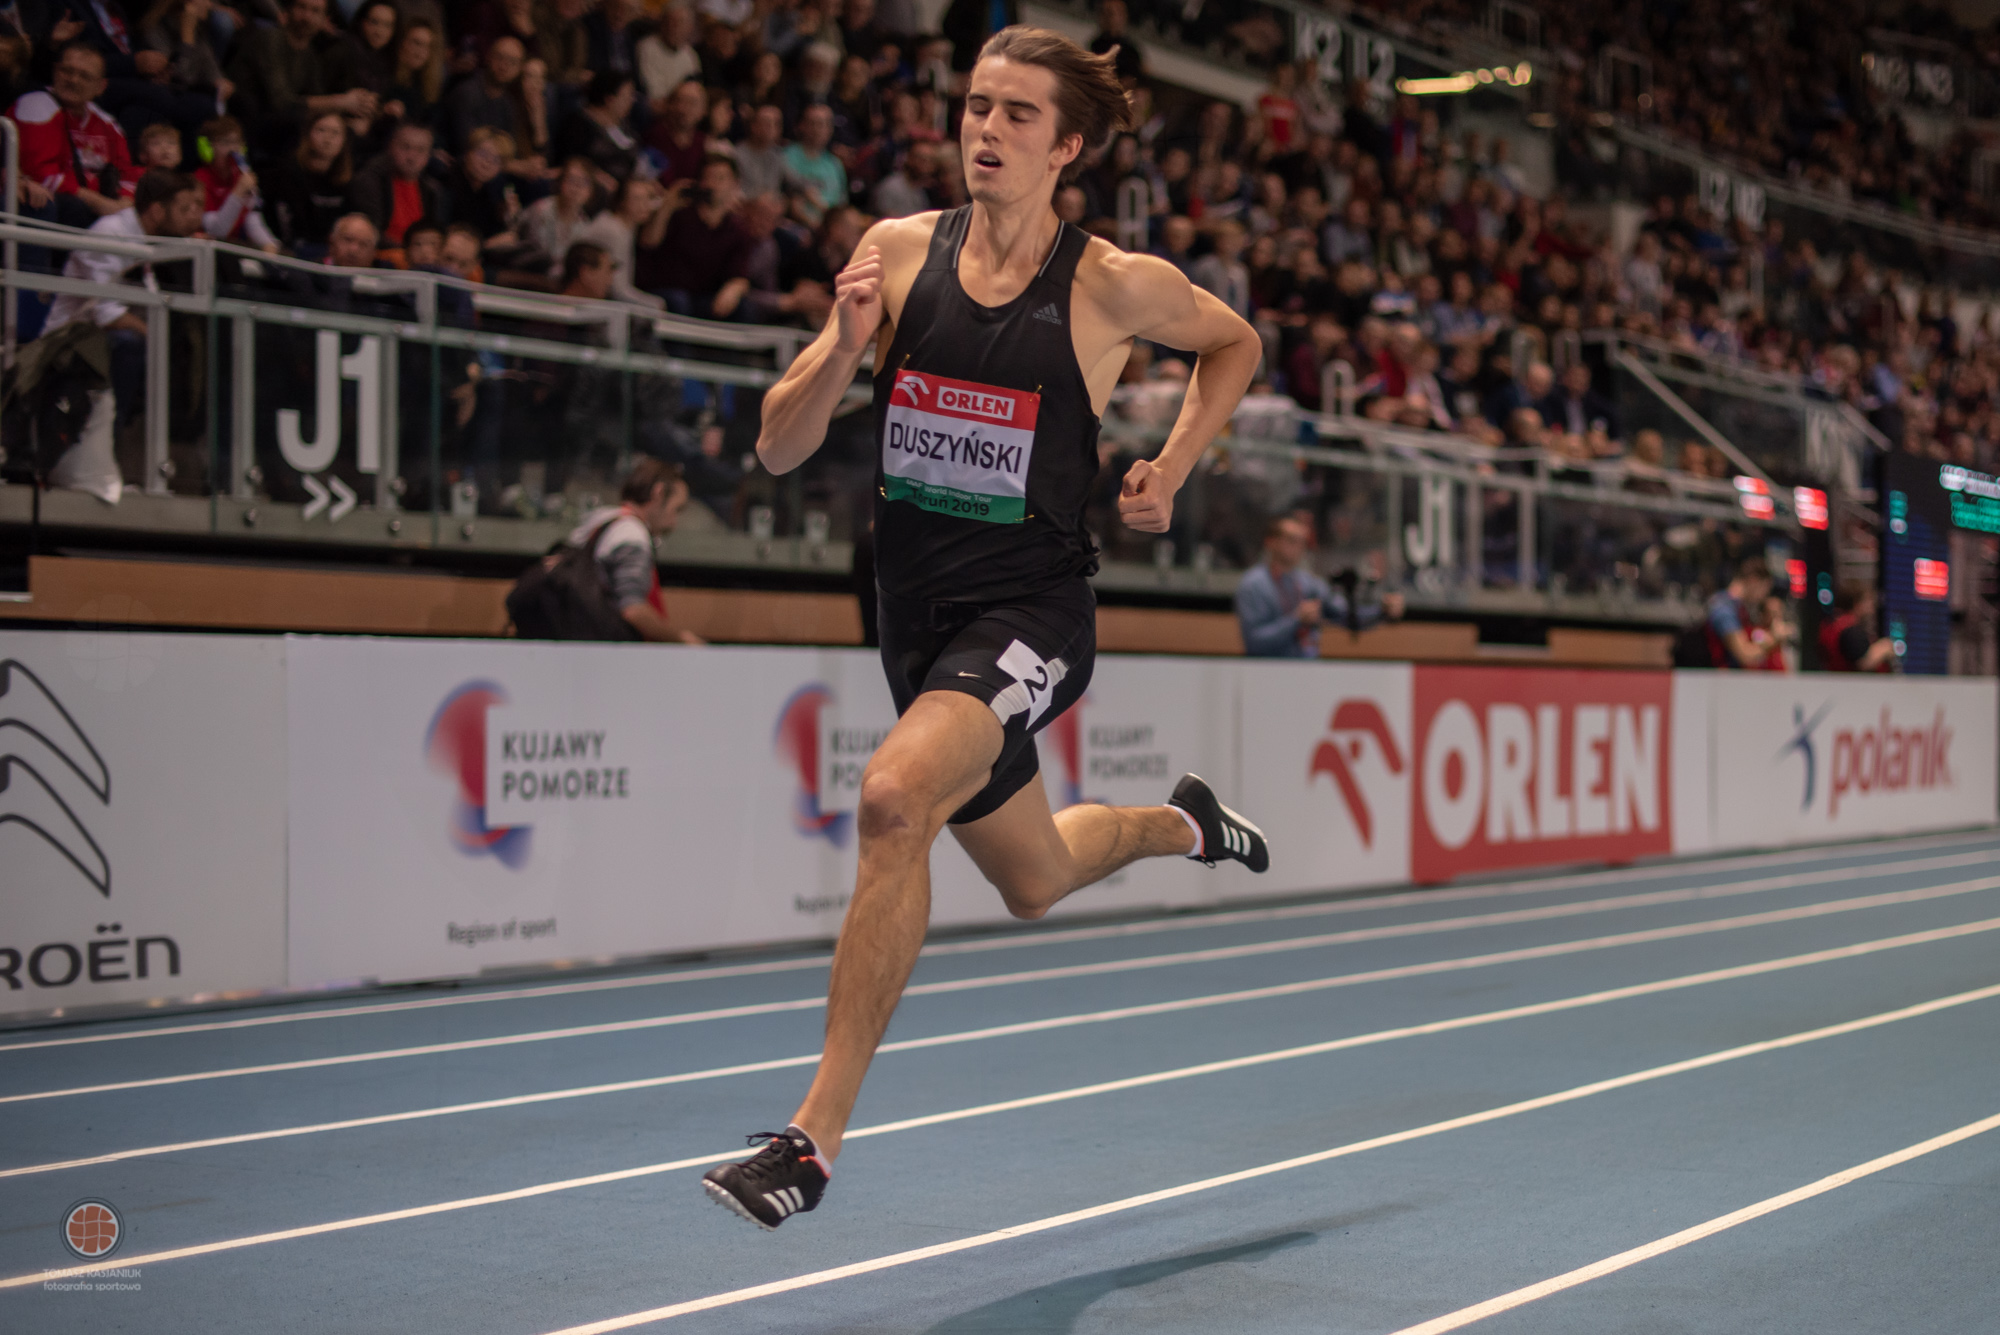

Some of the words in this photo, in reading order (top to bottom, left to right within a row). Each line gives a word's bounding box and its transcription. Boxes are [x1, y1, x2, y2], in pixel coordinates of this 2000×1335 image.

[1032, 312, 1062, 325] adidas
[276, 331, 380, 474] J1
[942, 391, 1009, 416] ORLEN
[890, 422, 1022, 474] DUSZYŃSKI
[924, 485, 948, 495] World
[949, 489, 972, 500] Indoor
[974, 494, 992, 503] Tour
[952, 499, 989, 516] 2019
[1023, 665, 1048, 704] 2
[502, 731, 606, 762] KUJAWY
[830, 729, 892, 753] KUJA
[1422, 699, 1661, 850] ORLEN
[1828, 703, 1953, 820] polanik
[502, 767, 630, 800] POMORZE
[448, 922, 497, 948] Region
[501, 917, 517, 938] of
[520, 918, 557, 941] sport
